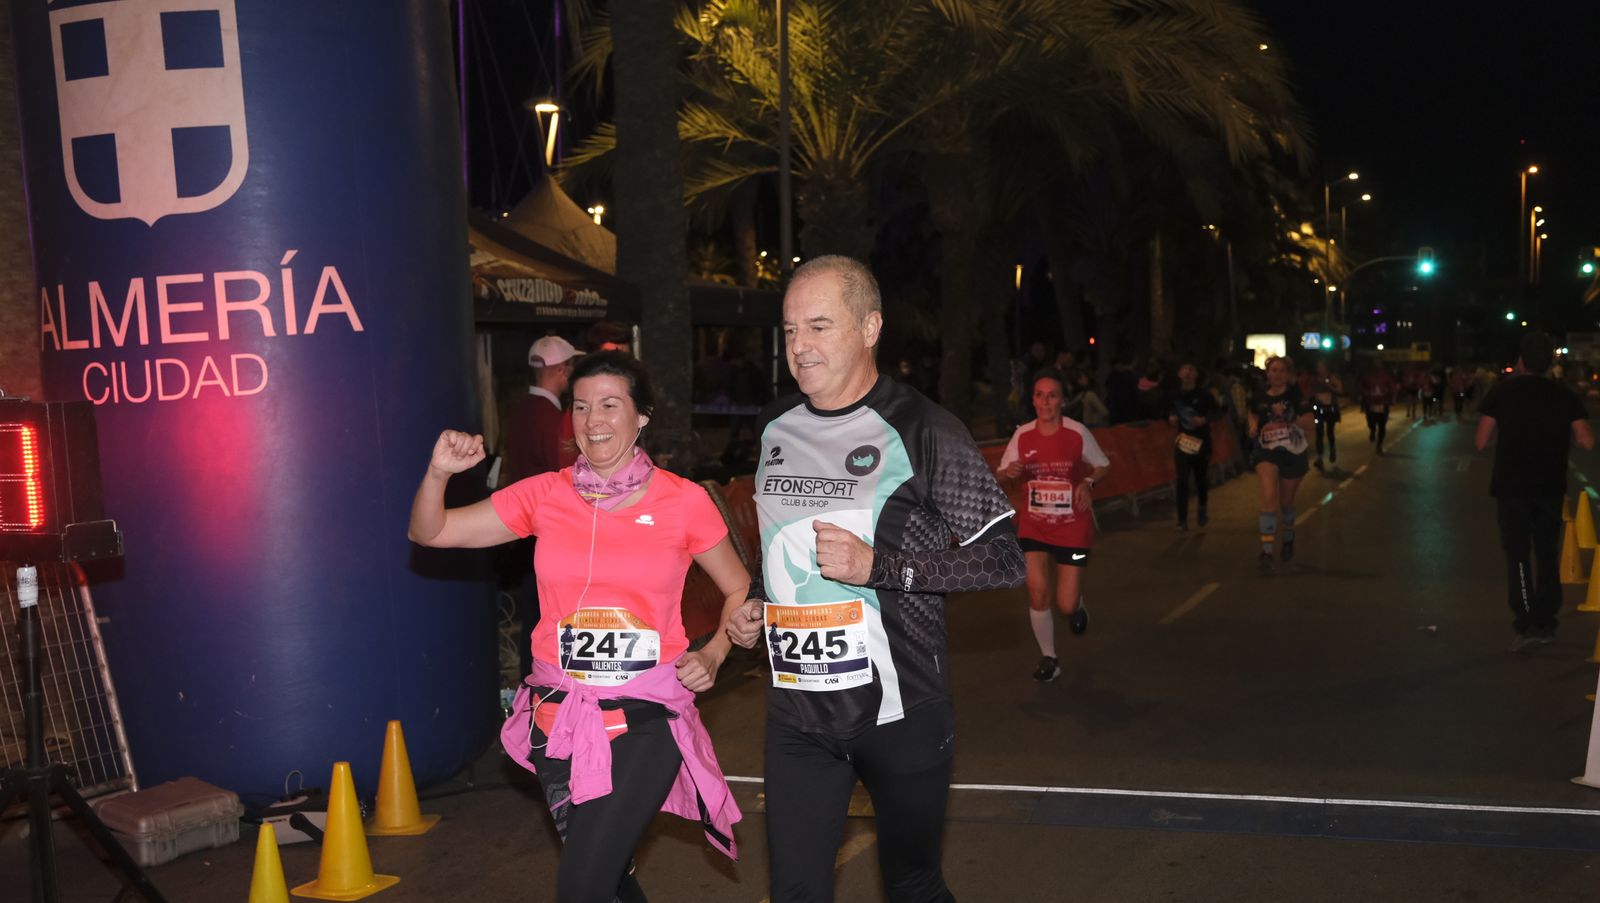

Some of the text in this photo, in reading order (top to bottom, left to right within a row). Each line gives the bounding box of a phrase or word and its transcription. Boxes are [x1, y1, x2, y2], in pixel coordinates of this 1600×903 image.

[41, 249, 364, 352] ALMERÍA
[83, 353, 269, 405] CIUDAD
[763, 479, 858, 496] ETONSPORT
[781, 498, 800, 506] CLUB
[808, 500, 829, 508] SHOP
[1036, 493, 1064, 502] 3184
[576, 631, 640, 658] 247
[782, 629, 849, 660] 245
[591, 661, 622, 670] VALIENTES
[800, 663, 828, 674] PAQUILLO
